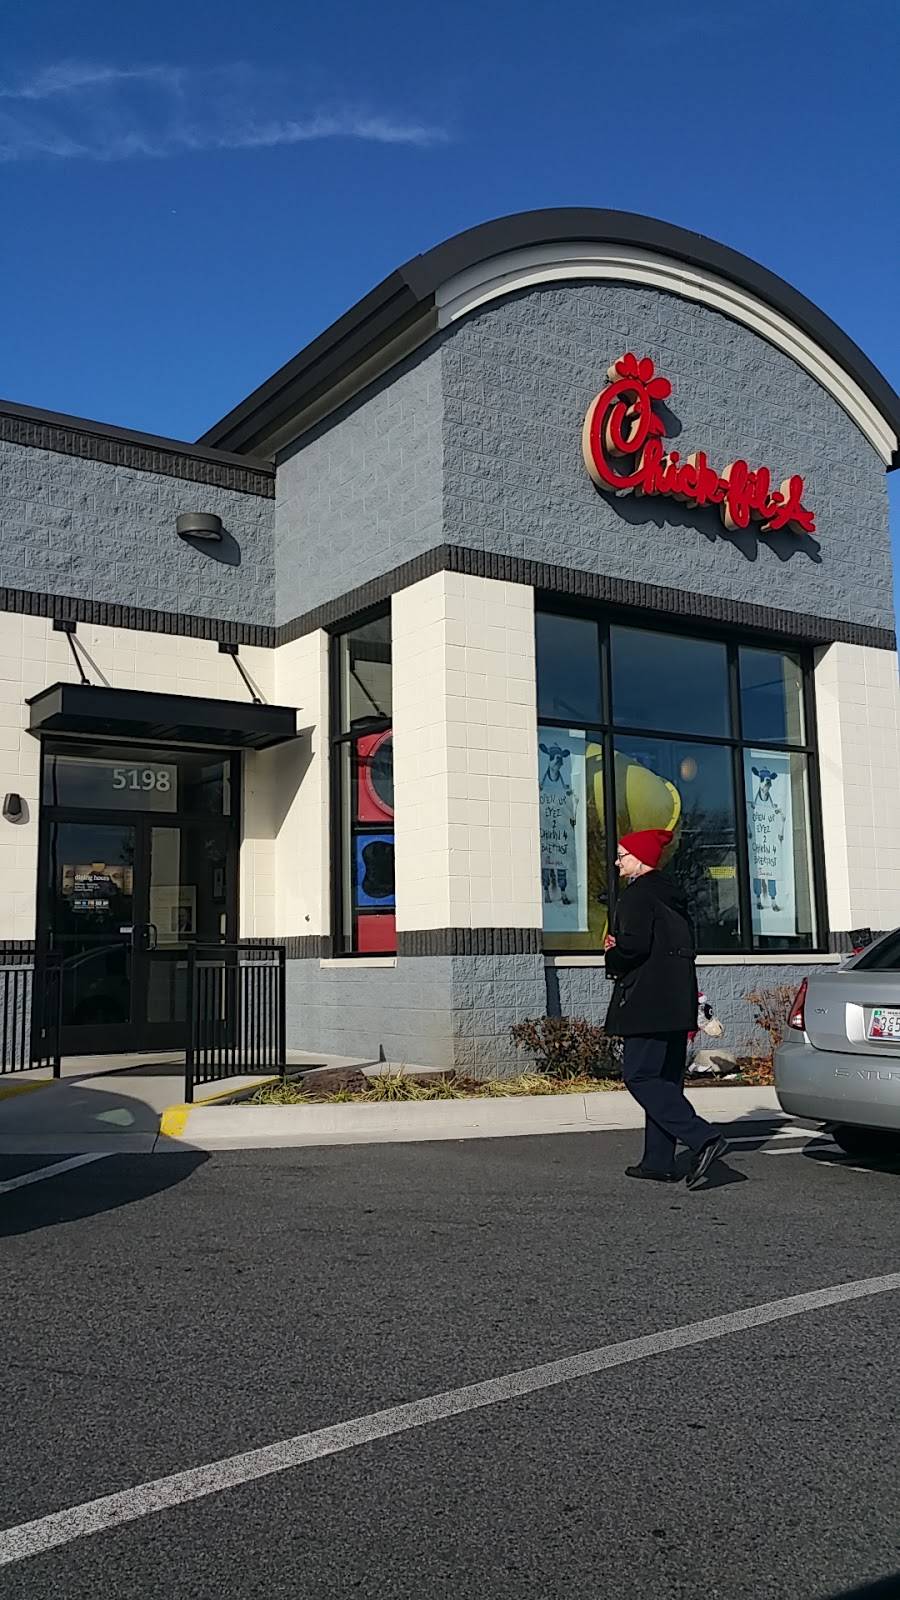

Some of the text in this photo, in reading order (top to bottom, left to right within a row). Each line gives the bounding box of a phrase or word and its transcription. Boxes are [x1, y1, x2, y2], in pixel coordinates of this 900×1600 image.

[582, 353, 816, 534] Chick-fil-A
[112, 769, 170, 791] 5198
[763, 835, 767, 843] 2
[75, 874, 92, 882] dining
